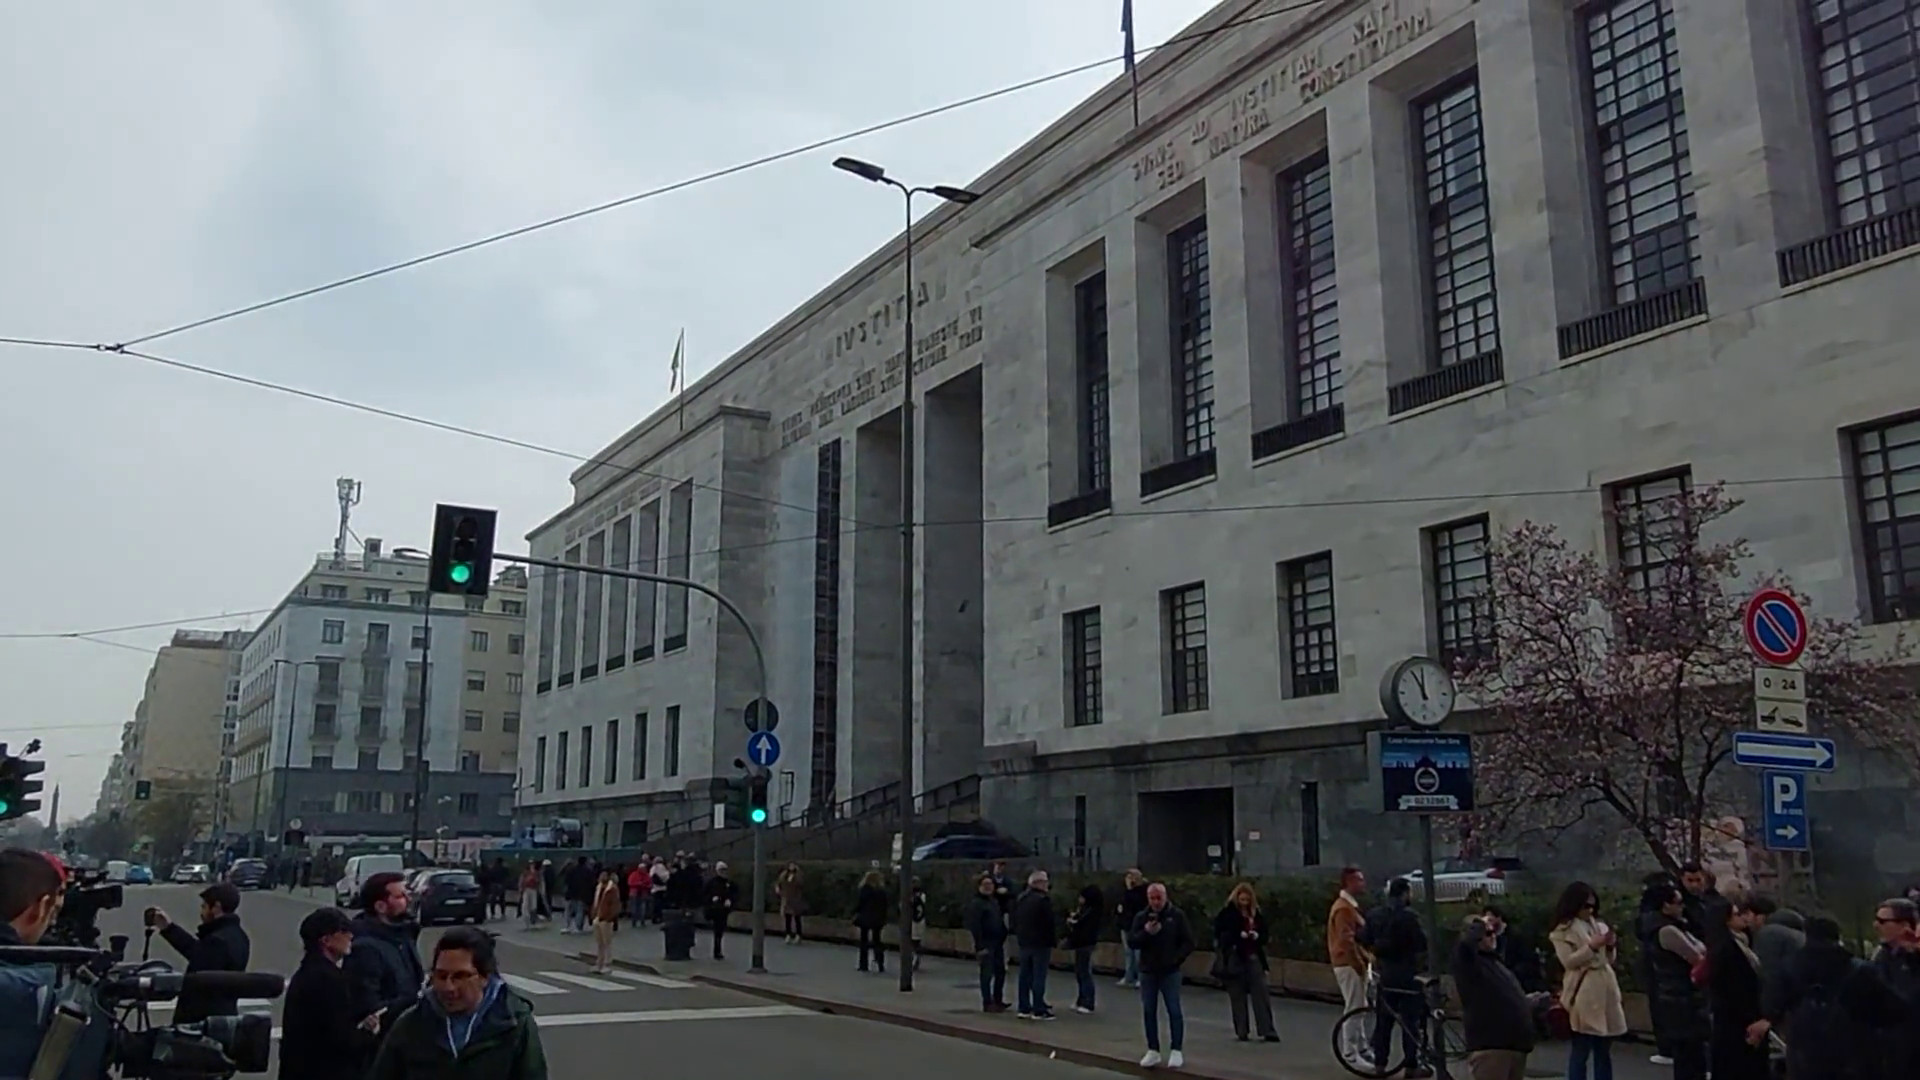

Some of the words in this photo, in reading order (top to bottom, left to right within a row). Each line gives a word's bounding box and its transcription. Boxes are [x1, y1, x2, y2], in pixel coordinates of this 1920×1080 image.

[1191, 117, 1211, 145] AD
[835, 281, 930, 358] IVSTITA
[1781, 678, 1797, 691] 24
[1773, 776, 1798, 814] P
